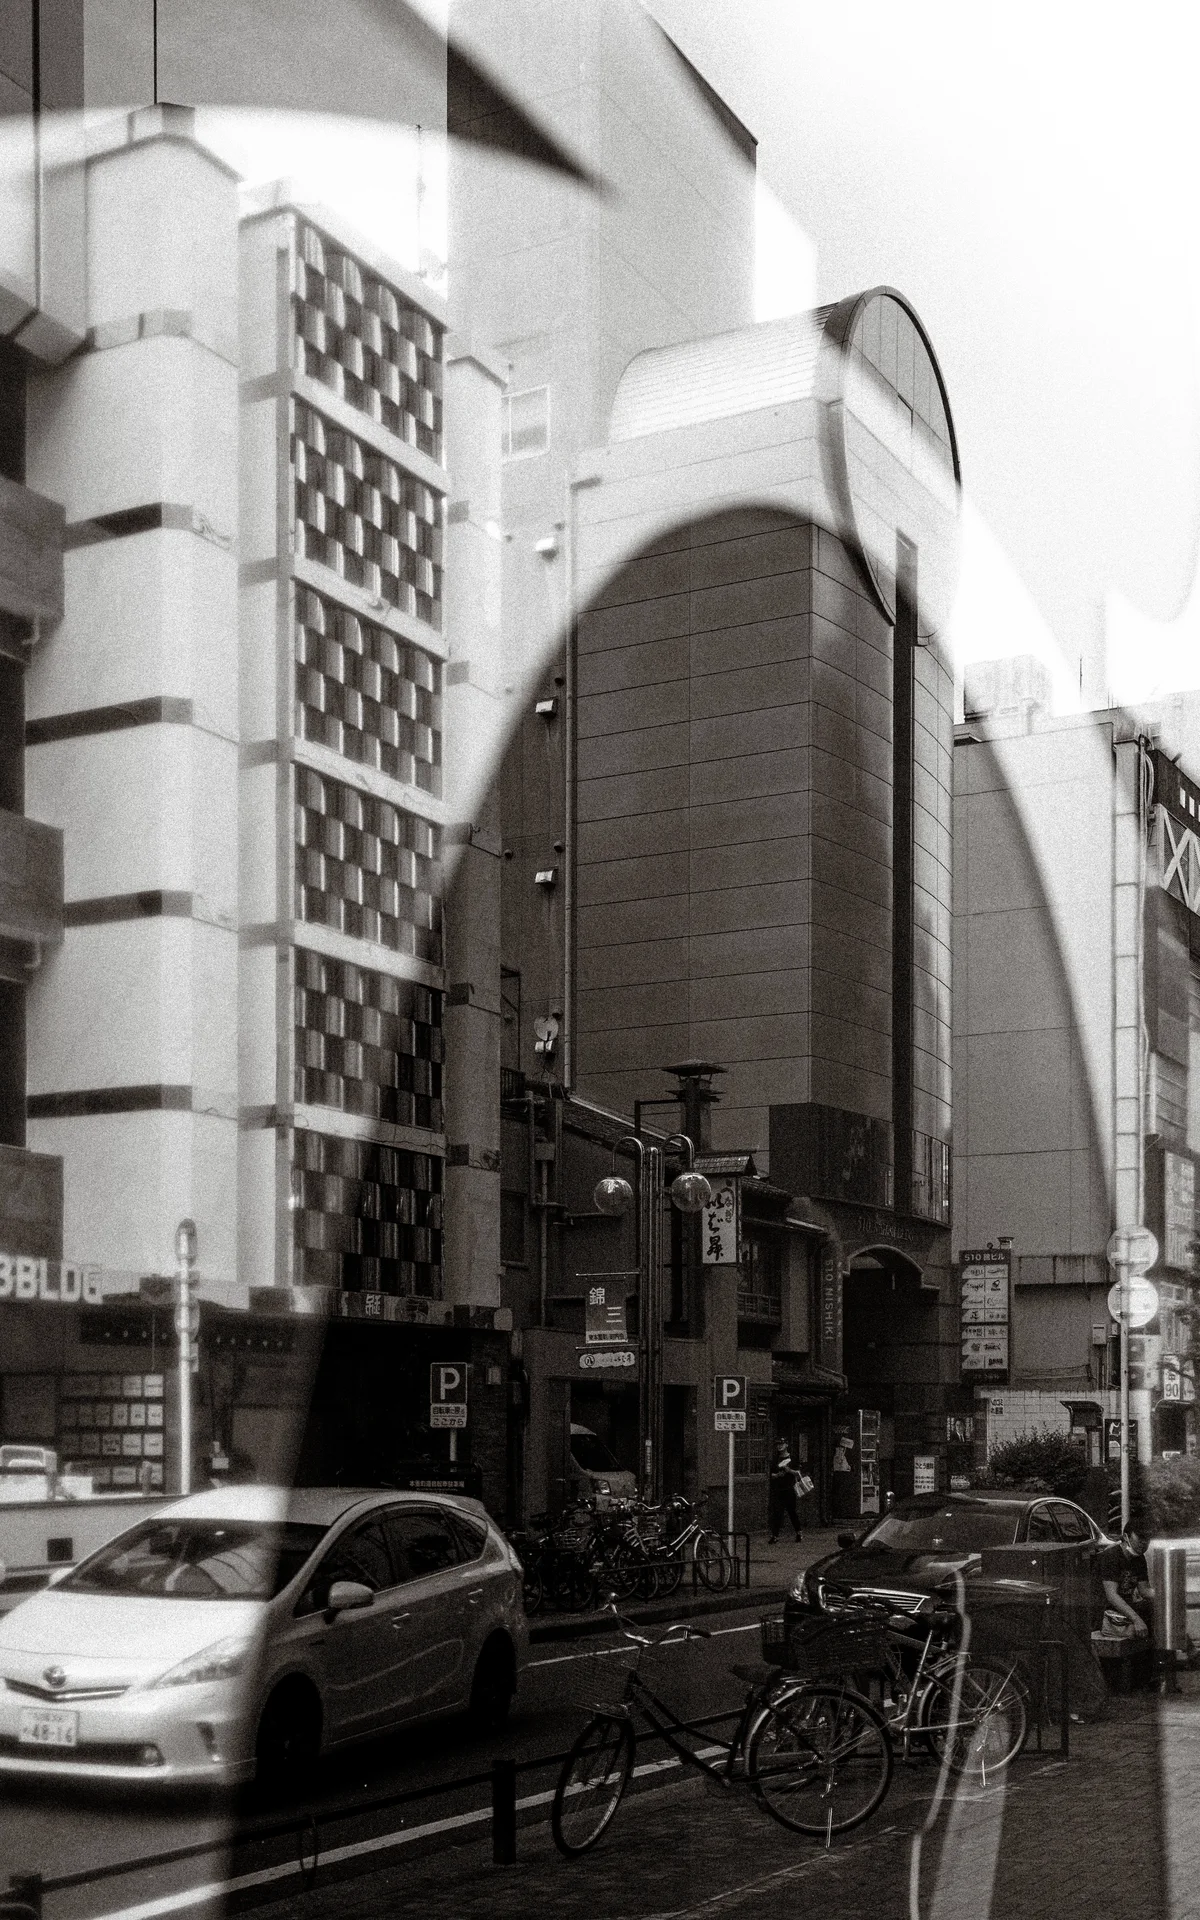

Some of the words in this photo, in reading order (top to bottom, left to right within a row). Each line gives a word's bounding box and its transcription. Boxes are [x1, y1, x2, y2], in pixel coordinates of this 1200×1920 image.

[824, 1287, 834, 1340] NISHIKI
[440, 1367, 461, 1400] P
[722, 1379, 741, 1406] P
[432, 1417, 464, 1426] ここから
[716, 1422, 745, 1430] ここまで
